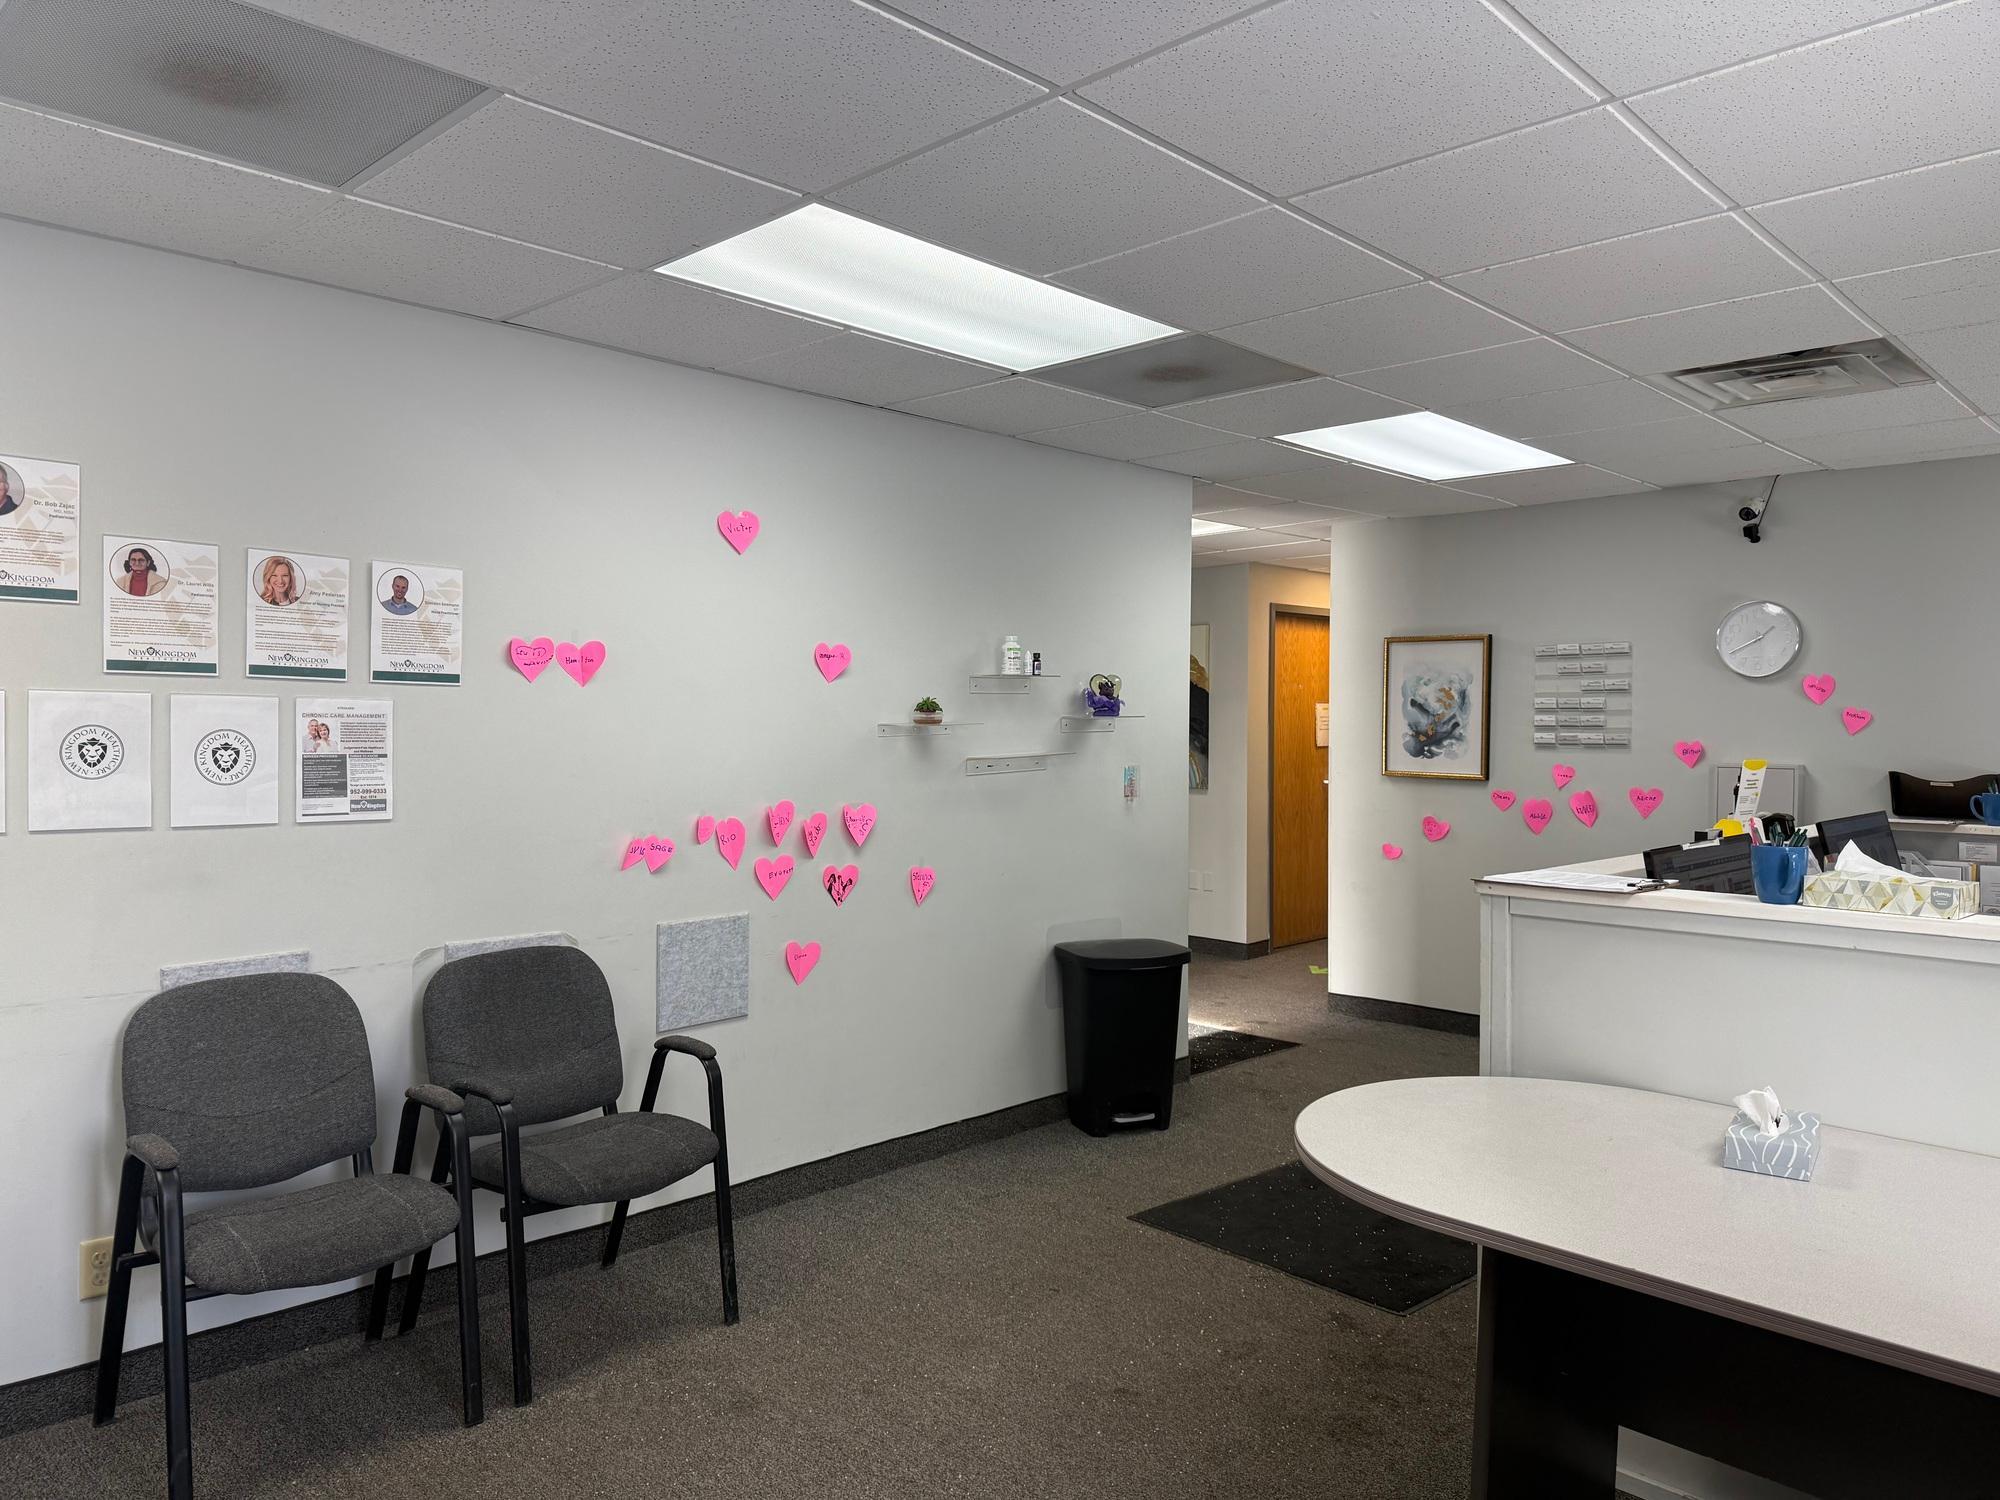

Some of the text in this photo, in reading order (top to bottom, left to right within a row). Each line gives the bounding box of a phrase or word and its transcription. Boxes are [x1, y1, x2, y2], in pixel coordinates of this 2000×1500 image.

[7, 573, 55, 584] KINGDOM
[128, 648, 197, 659] NEW KINGDOM
[268, 654, 329, 664] NEW KINGDOM
[390, 660, 445, 670] NEW KINGDOM
[65, 728, 121, 776] NEW KINGDOM HEALTHCARE
[199, 732, 253, 782] NEW KINGDOM HEALTHCARE
